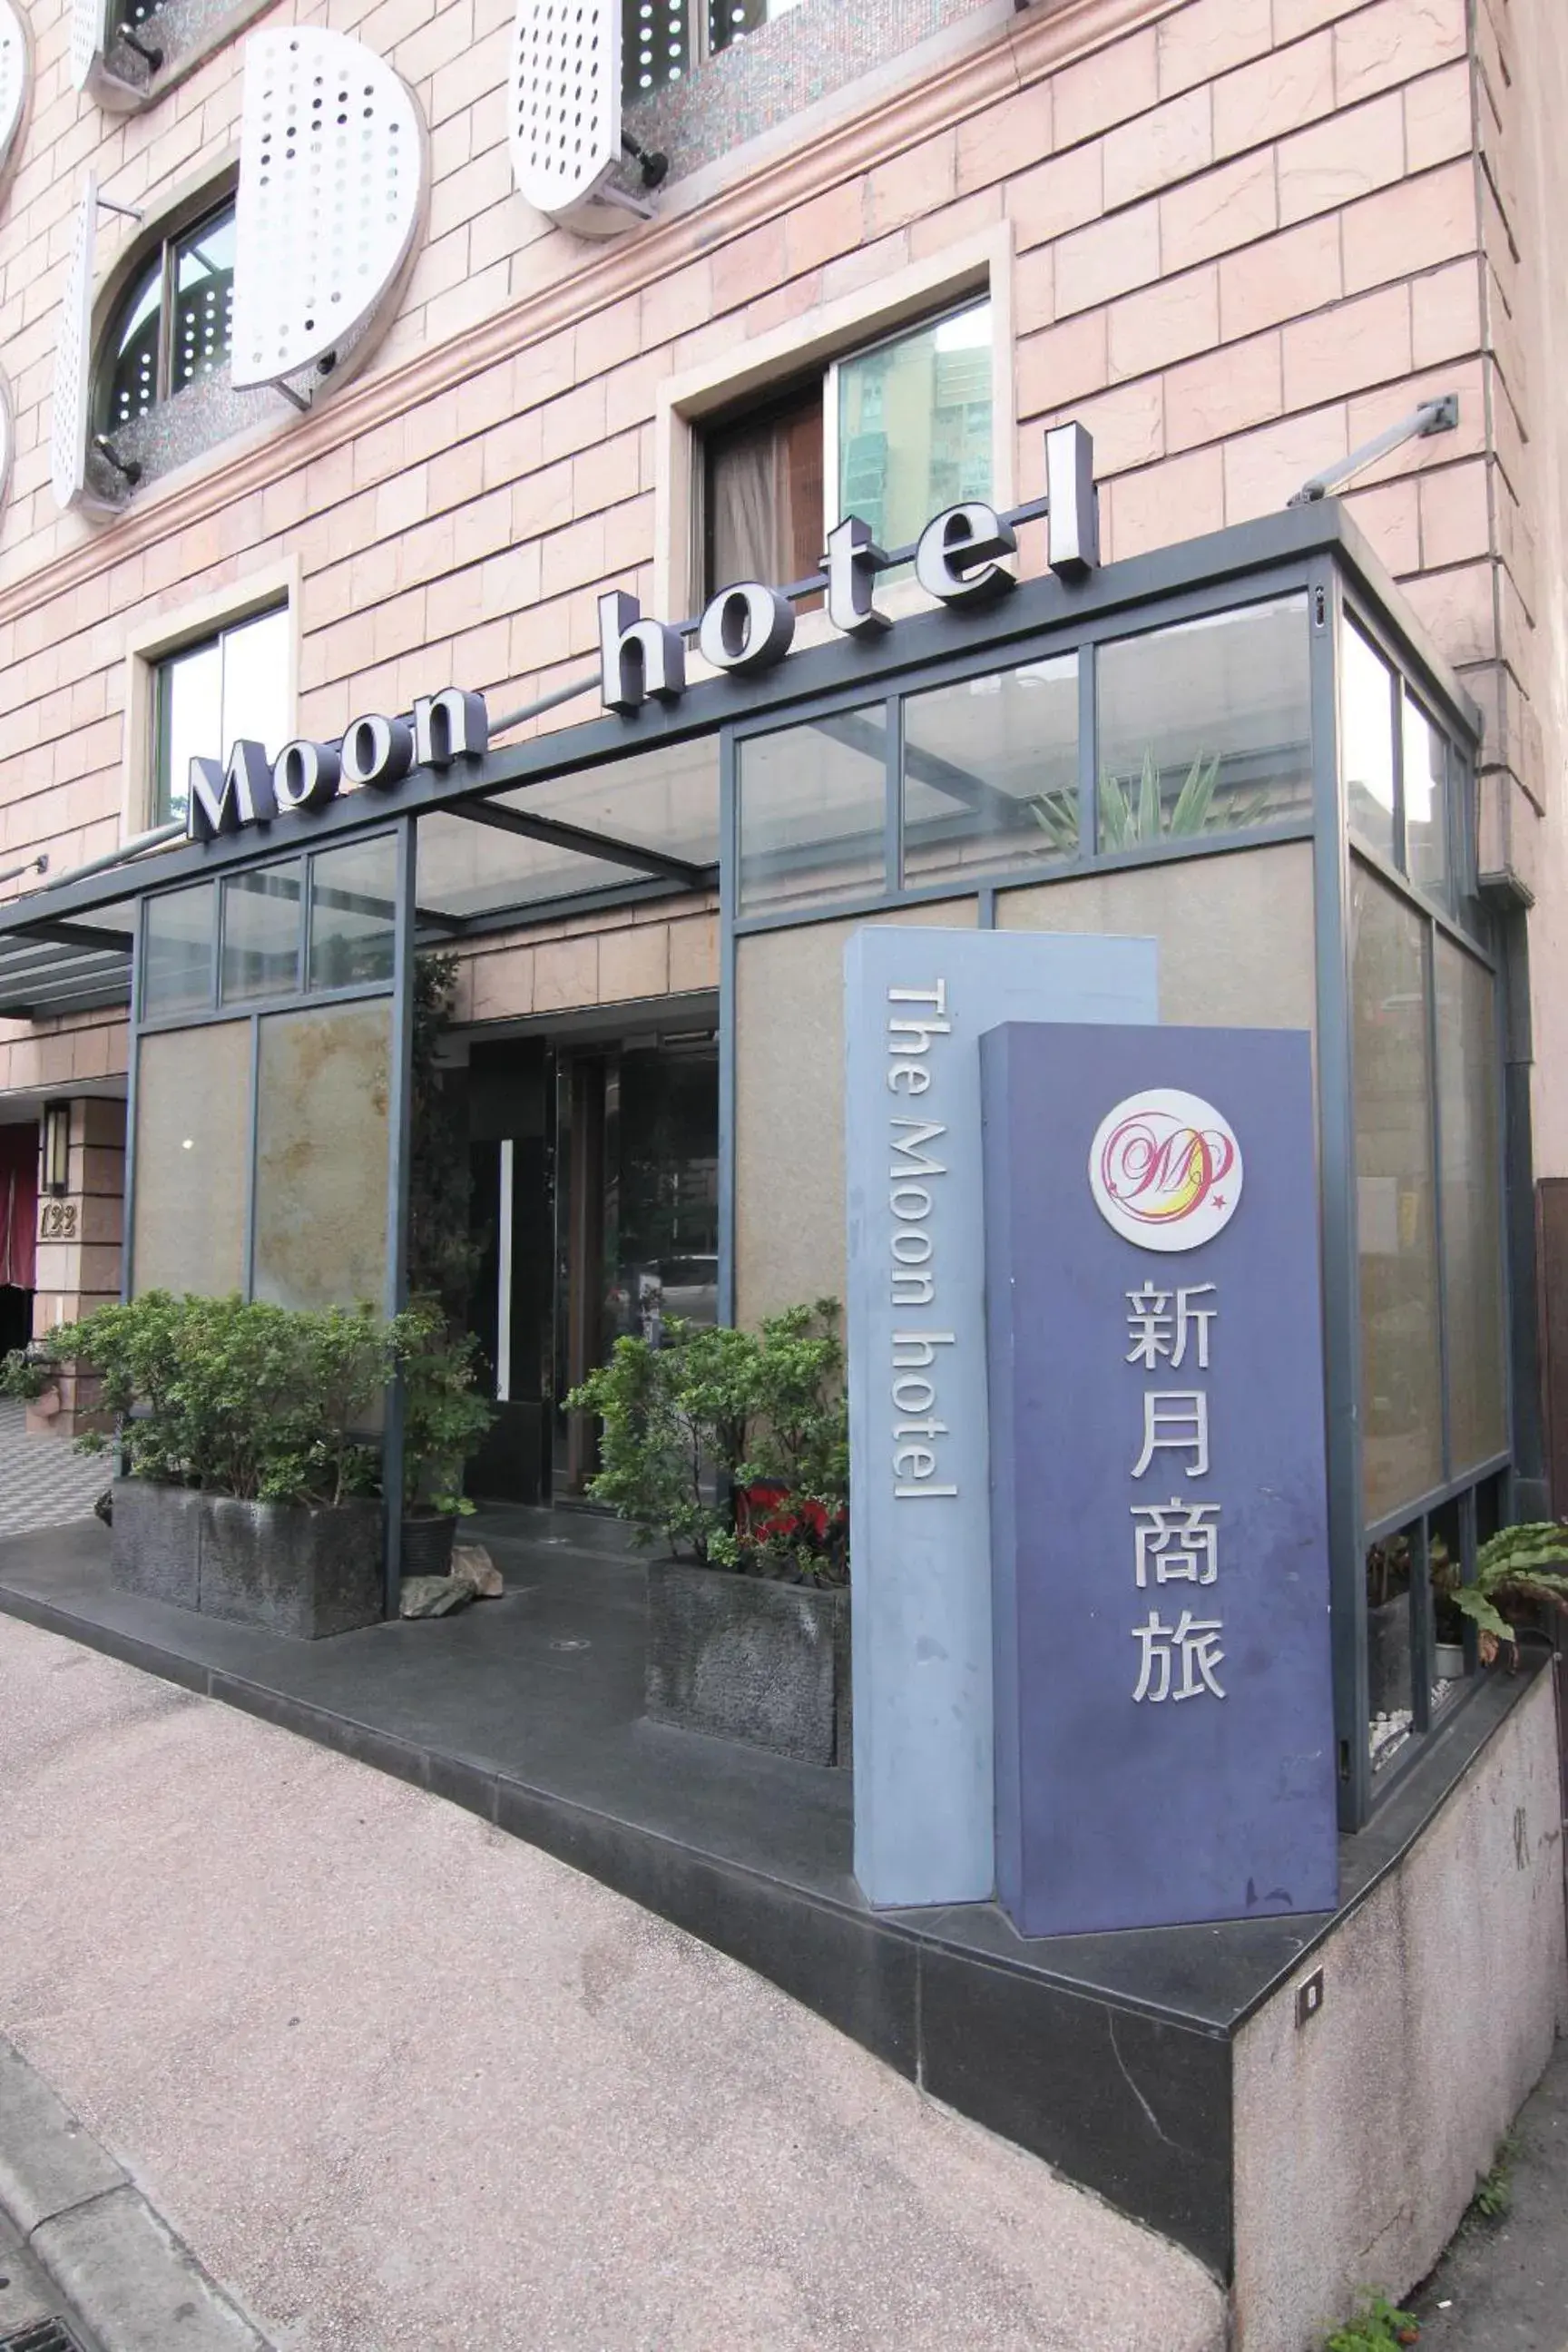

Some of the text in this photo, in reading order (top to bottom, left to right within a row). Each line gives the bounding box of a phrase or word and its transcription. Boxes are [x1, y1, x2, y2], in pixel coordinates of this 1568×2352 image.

[187, 419, 1100, 840] Moon hotel
[886, 978, 958, 1499] The Moon hotel
[1124, 1279, 1229, 1703] 新月商旅
